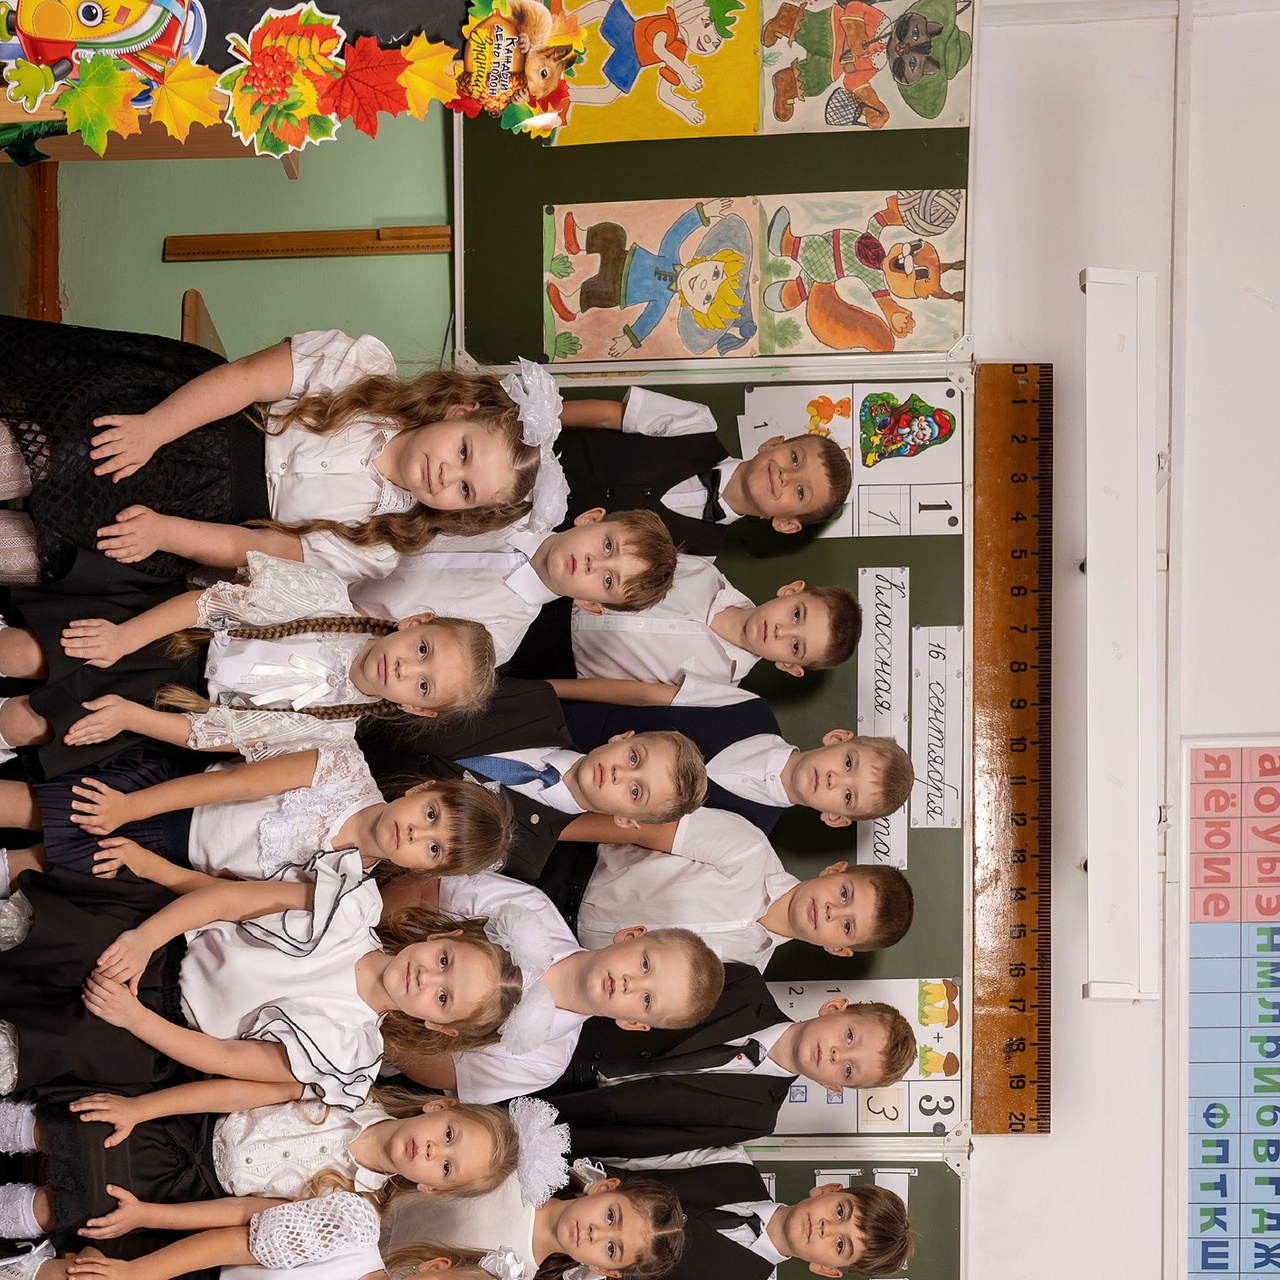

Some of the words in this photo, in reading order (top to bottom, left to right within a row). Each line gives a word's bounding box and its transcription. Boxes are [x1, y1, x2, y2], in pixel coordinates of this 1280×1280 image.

[469, 31, 493, 95] Знаний!
[1011, 364, 1027, 374] 0
[754, 421, 769, 429] 1
[1011, 434, 1027, 444] 2
[1011, 473, 1027, 484] 3
[918, 499, 952, 514] 1
[867, 510, 900, 526] 1
[1011, 511, 1027, 523] 4
[1011, 550, 1027, 559] 5
[1011, 585, 1027, 597] 6
[1010, 624, 1027, 634] 7
[874, 574, 906, 716] Классная
[928, 642, 947, 660] 16
[1010, 661, 1027, 673] 8
[1010, 699, 1027, 709] 9
[914, 681, 958, 821] сентября
[1010, 736, 1027, 753] 10
[1010, 775, 1027, 786] 11
[1009, 812, 1026, 827] 12
[1009, 923, 1026, 939] 15
[1009, 961, 1026, 978] 16
[788, 986, 804, 996] 2
[1009, 998, 1026, 1013] 17
[1009, 1074, 1026, 1090] 19
[866, 1095, 899, 1121] 3
[919, 1094, 955, 1117] 3
[1009, 1112, 1026, 1133] 20
